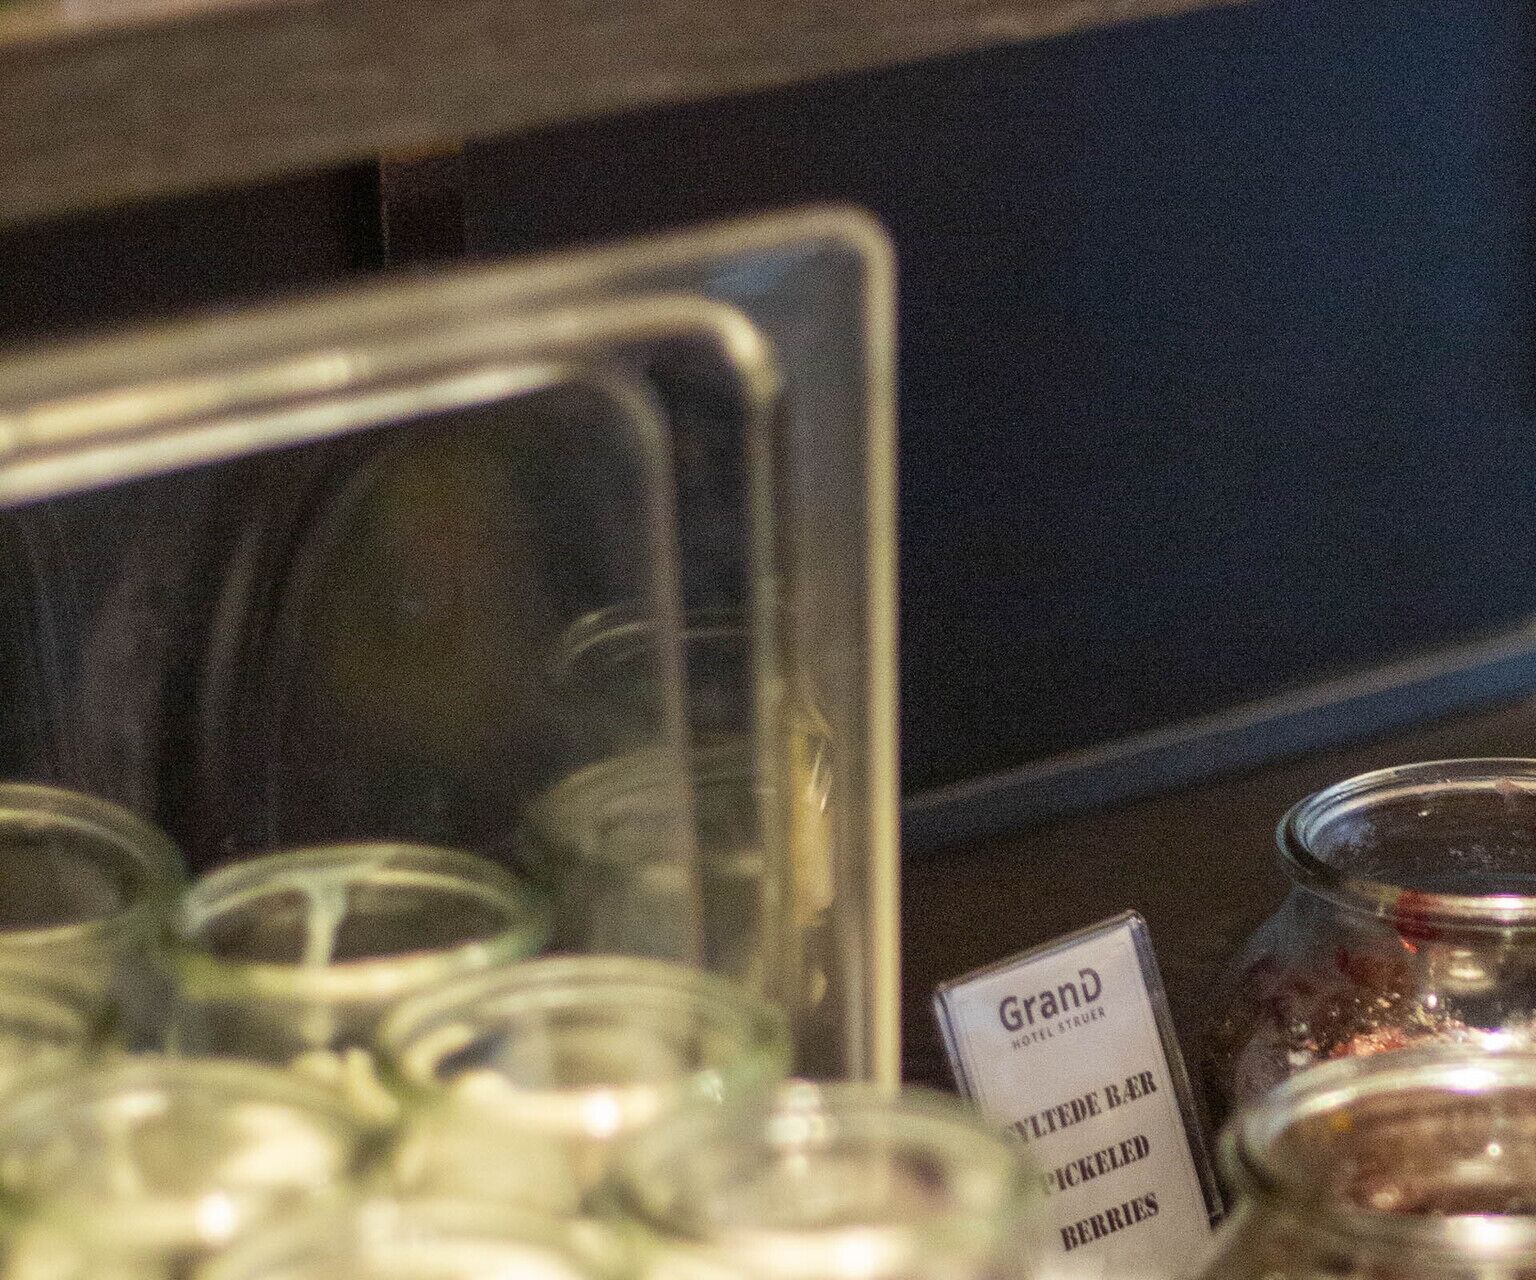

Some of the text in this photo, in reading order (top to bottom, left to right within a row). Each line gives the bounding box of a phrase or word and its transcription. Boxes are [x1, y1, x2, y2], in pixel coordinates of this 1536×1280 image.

[1012, 1005, 1107, 1051] HOTEL STRUER
[1103, 1070, 1158, 1112] BÆR
[1059, 1192, 1161, 1252] BERRIES
